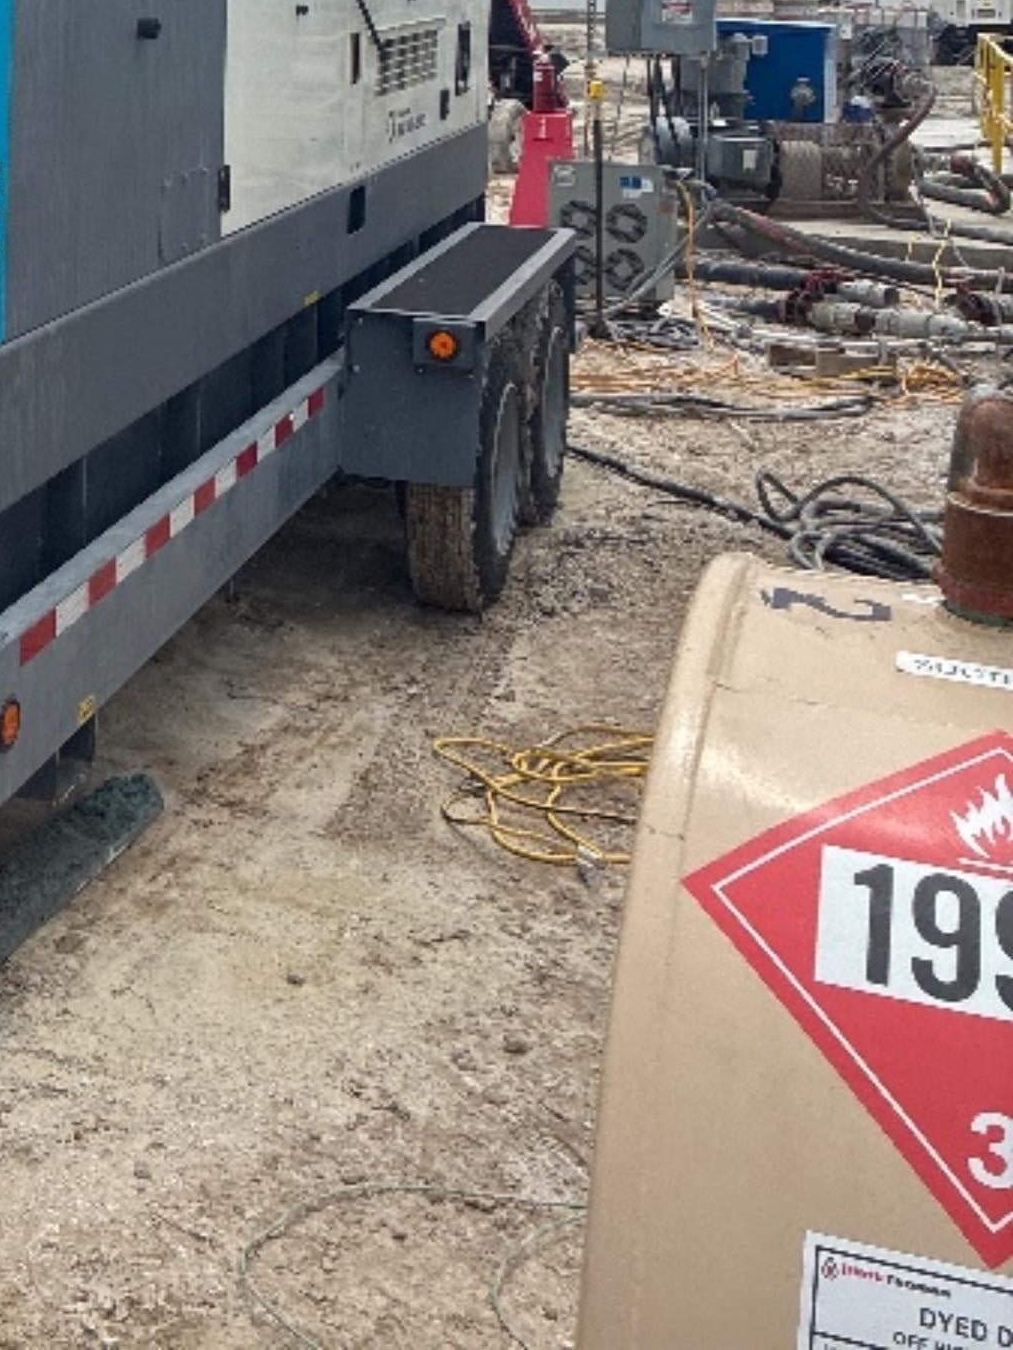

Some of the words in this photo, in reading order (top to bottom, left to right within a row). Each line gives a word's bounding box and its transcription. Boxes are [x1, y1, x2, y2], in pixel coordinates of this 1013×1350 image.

[853, 864, 1013, 1012] 19
[968, 1111, 1013, 1189] 3
[920, 1307, 988, 1342] DYED
